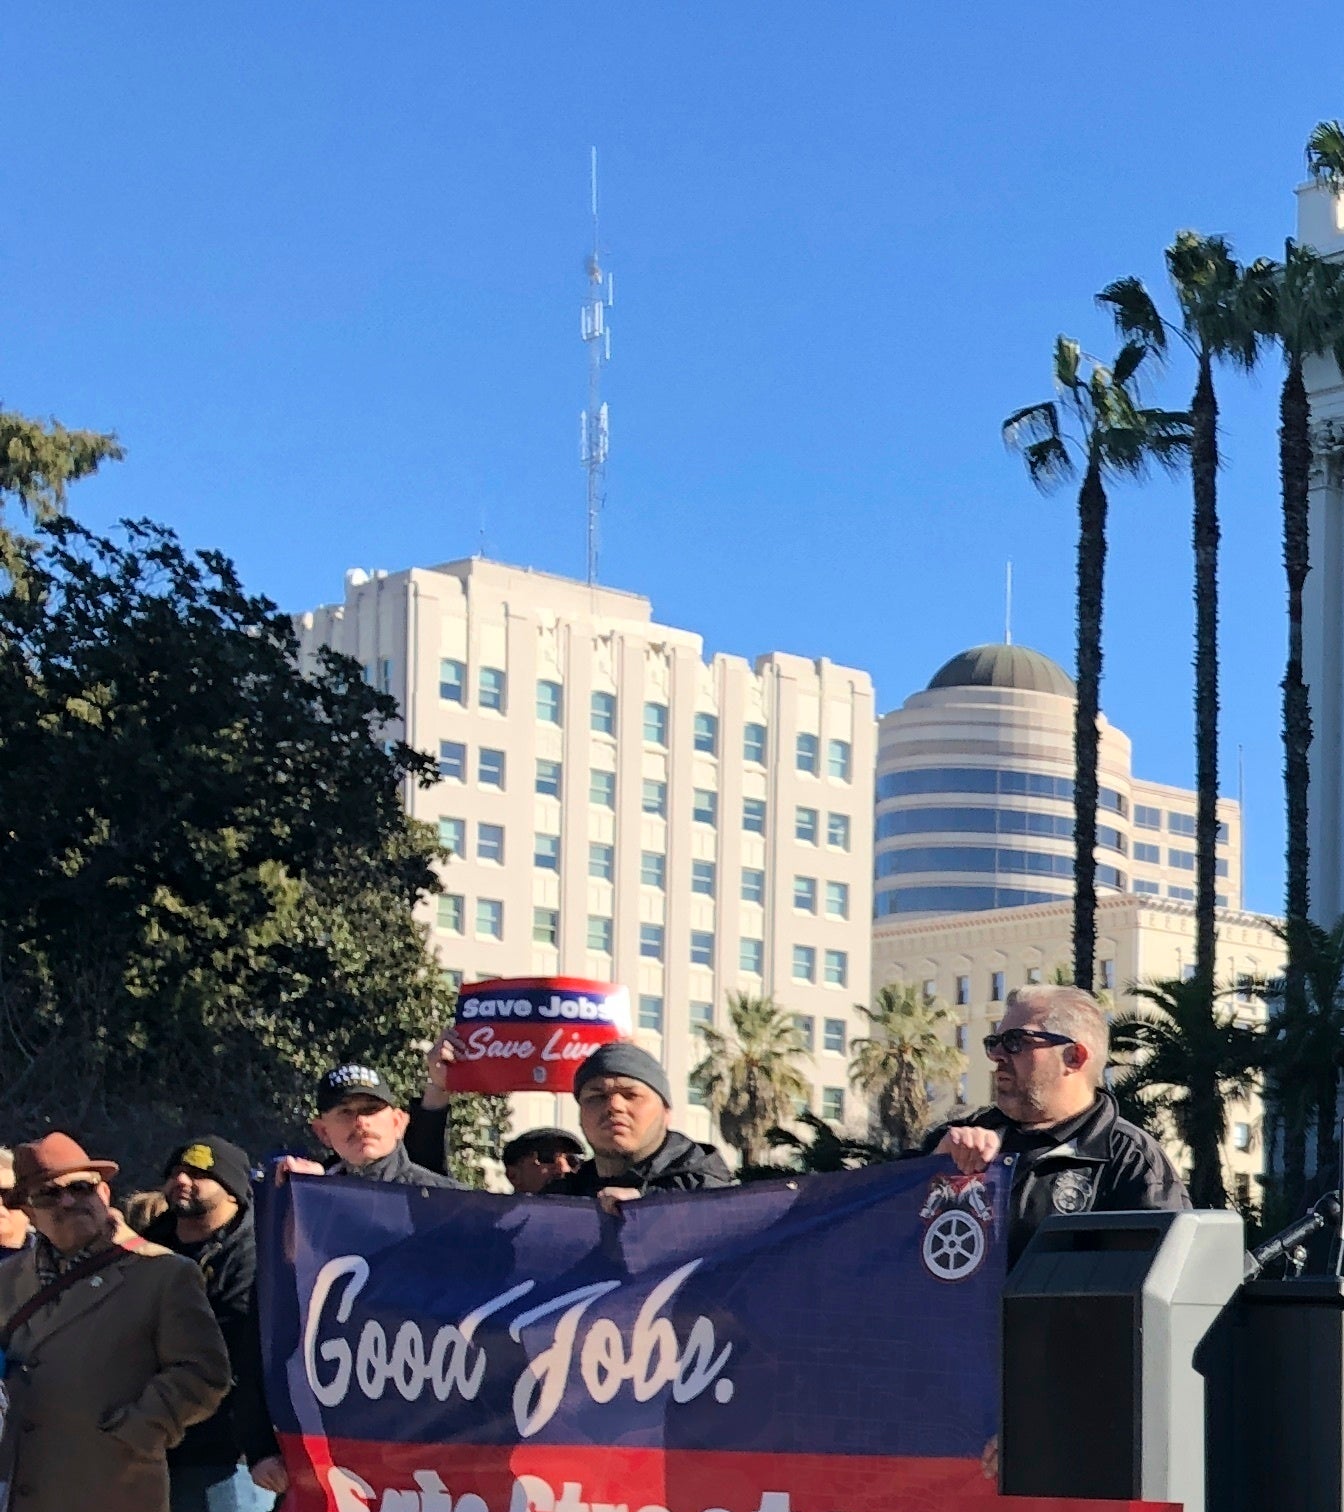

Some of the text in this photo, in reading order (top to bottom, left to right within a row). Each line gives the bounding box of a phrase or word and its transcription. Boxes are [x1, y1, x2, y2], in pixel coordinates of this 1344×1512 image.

[462, 998, 533, 1019] Save
[465, 1026, 535, 1061] Save
[304, 1254, 735, 1438] Good Jobs.
